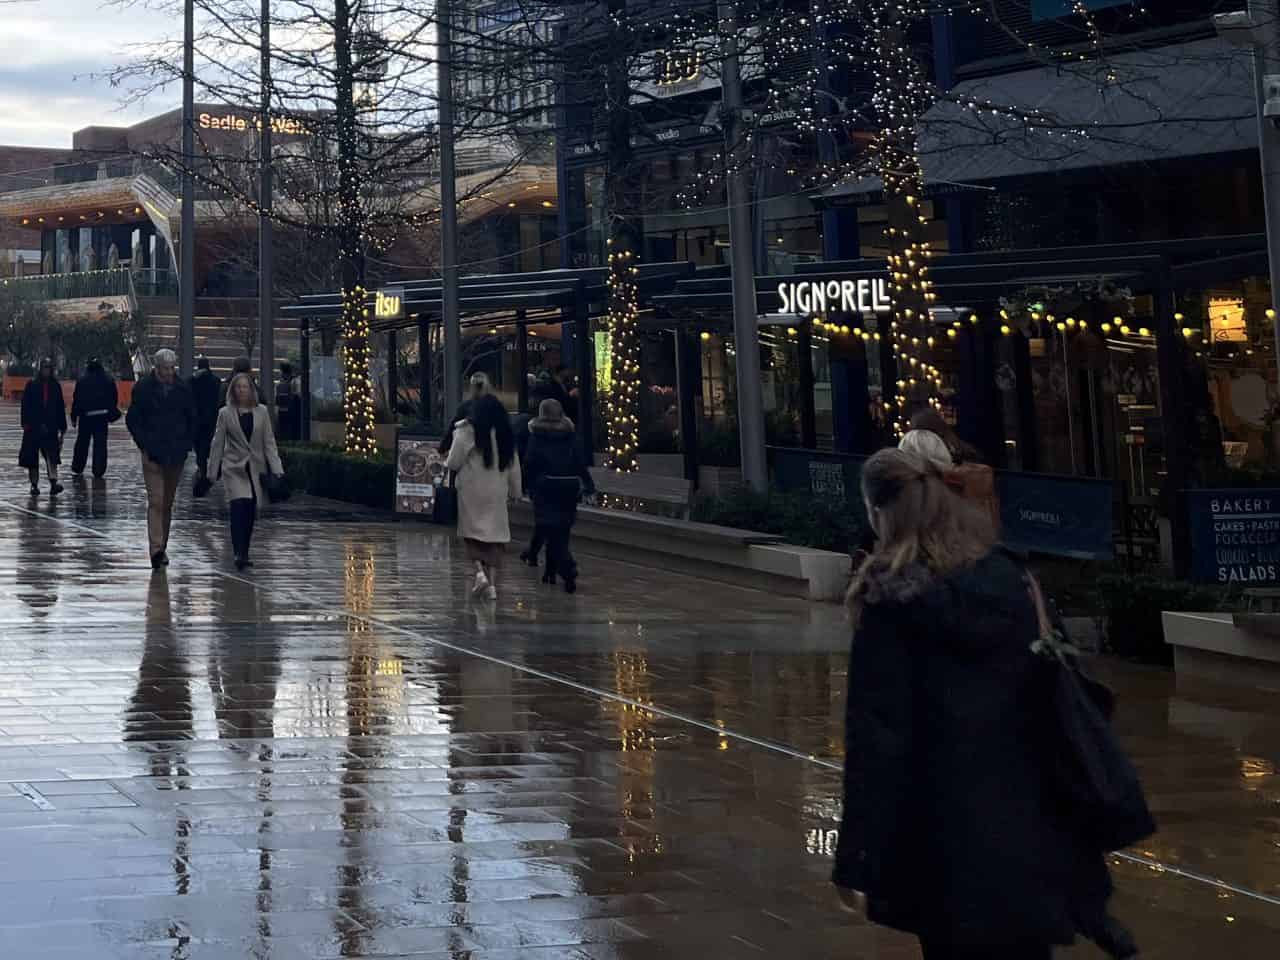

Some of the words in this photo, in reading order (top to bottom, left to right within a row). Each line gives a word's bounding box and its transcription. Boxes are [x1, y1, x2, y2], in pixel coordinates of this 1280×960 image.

[375, 290, 401, 316] itsu
[1210, 498, 1273, 513] BAKERY
[1214, 521, 1245, 532] CAKES
[1218, 565, 1277, 582] SALADS
